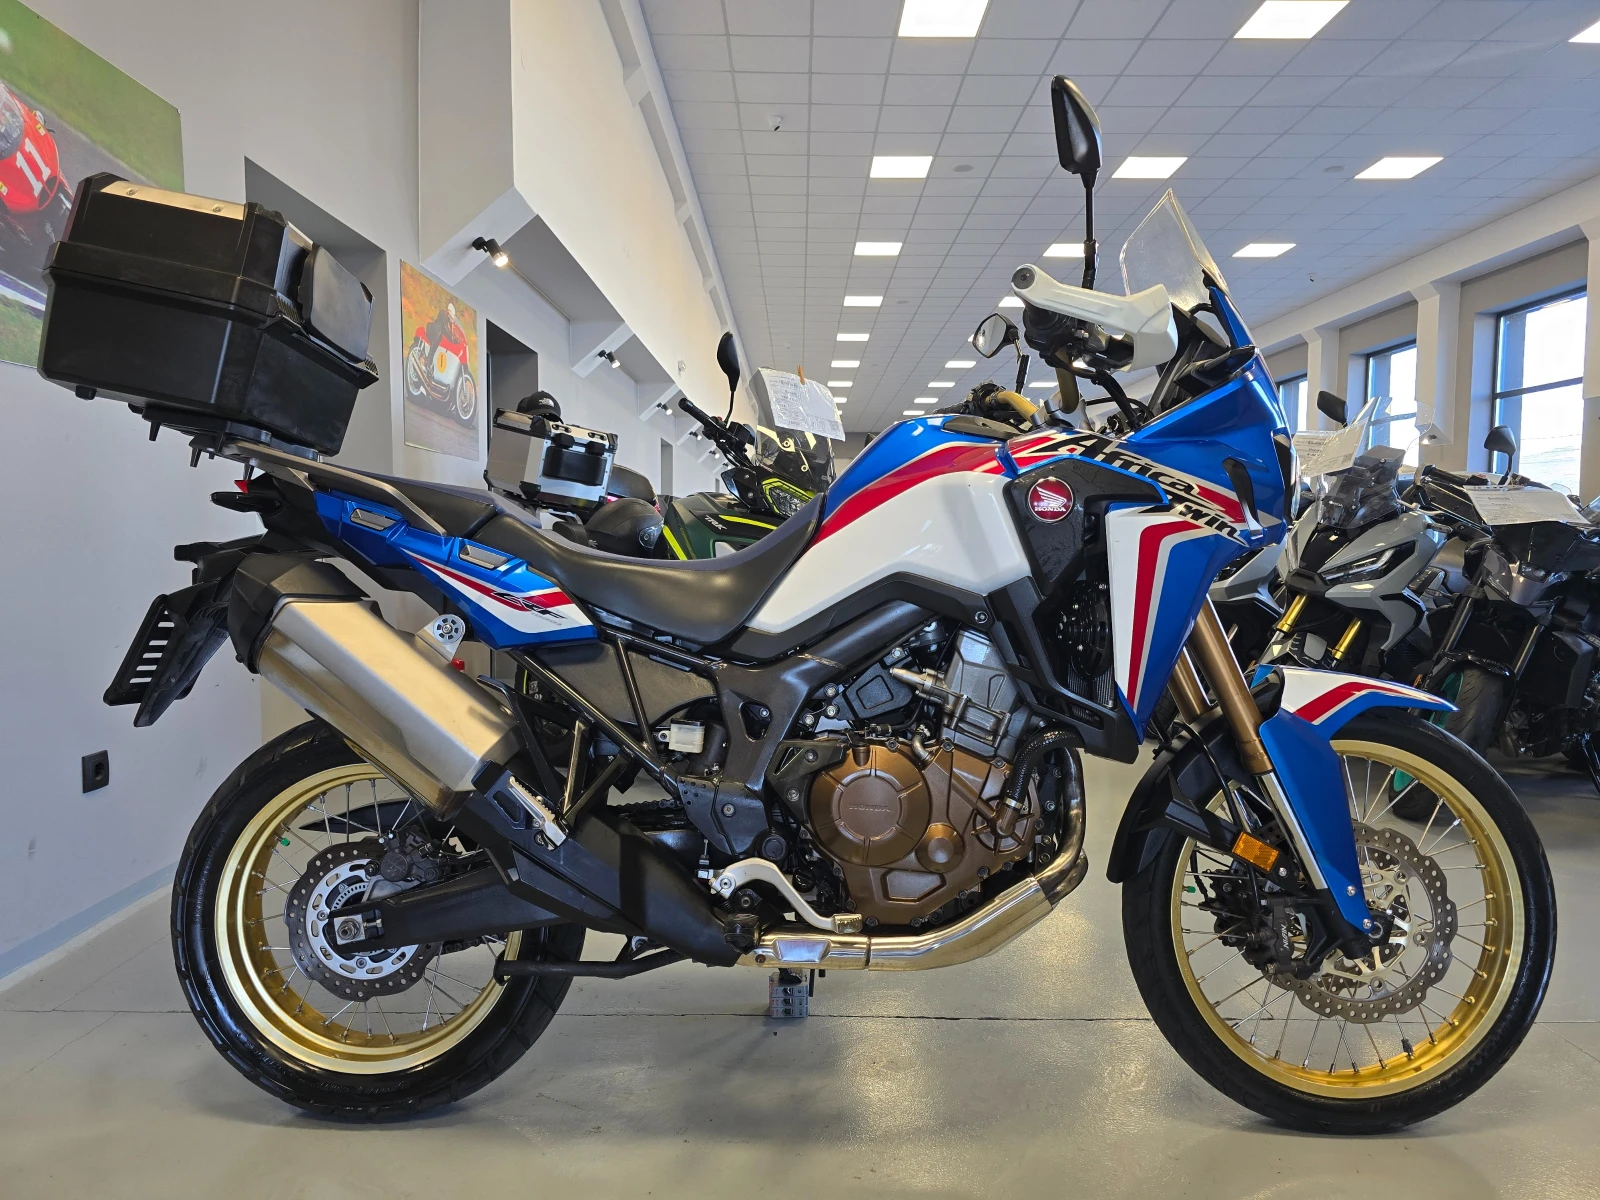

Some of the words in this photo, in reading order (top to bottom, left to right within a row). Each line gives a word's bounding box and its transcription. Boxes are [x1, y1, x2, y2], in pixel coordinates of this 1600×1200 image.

[16, 137, 51, 198] 11
[1027, 434, 1212, 504] Africa
[704, 514, 728, 530] TRK
